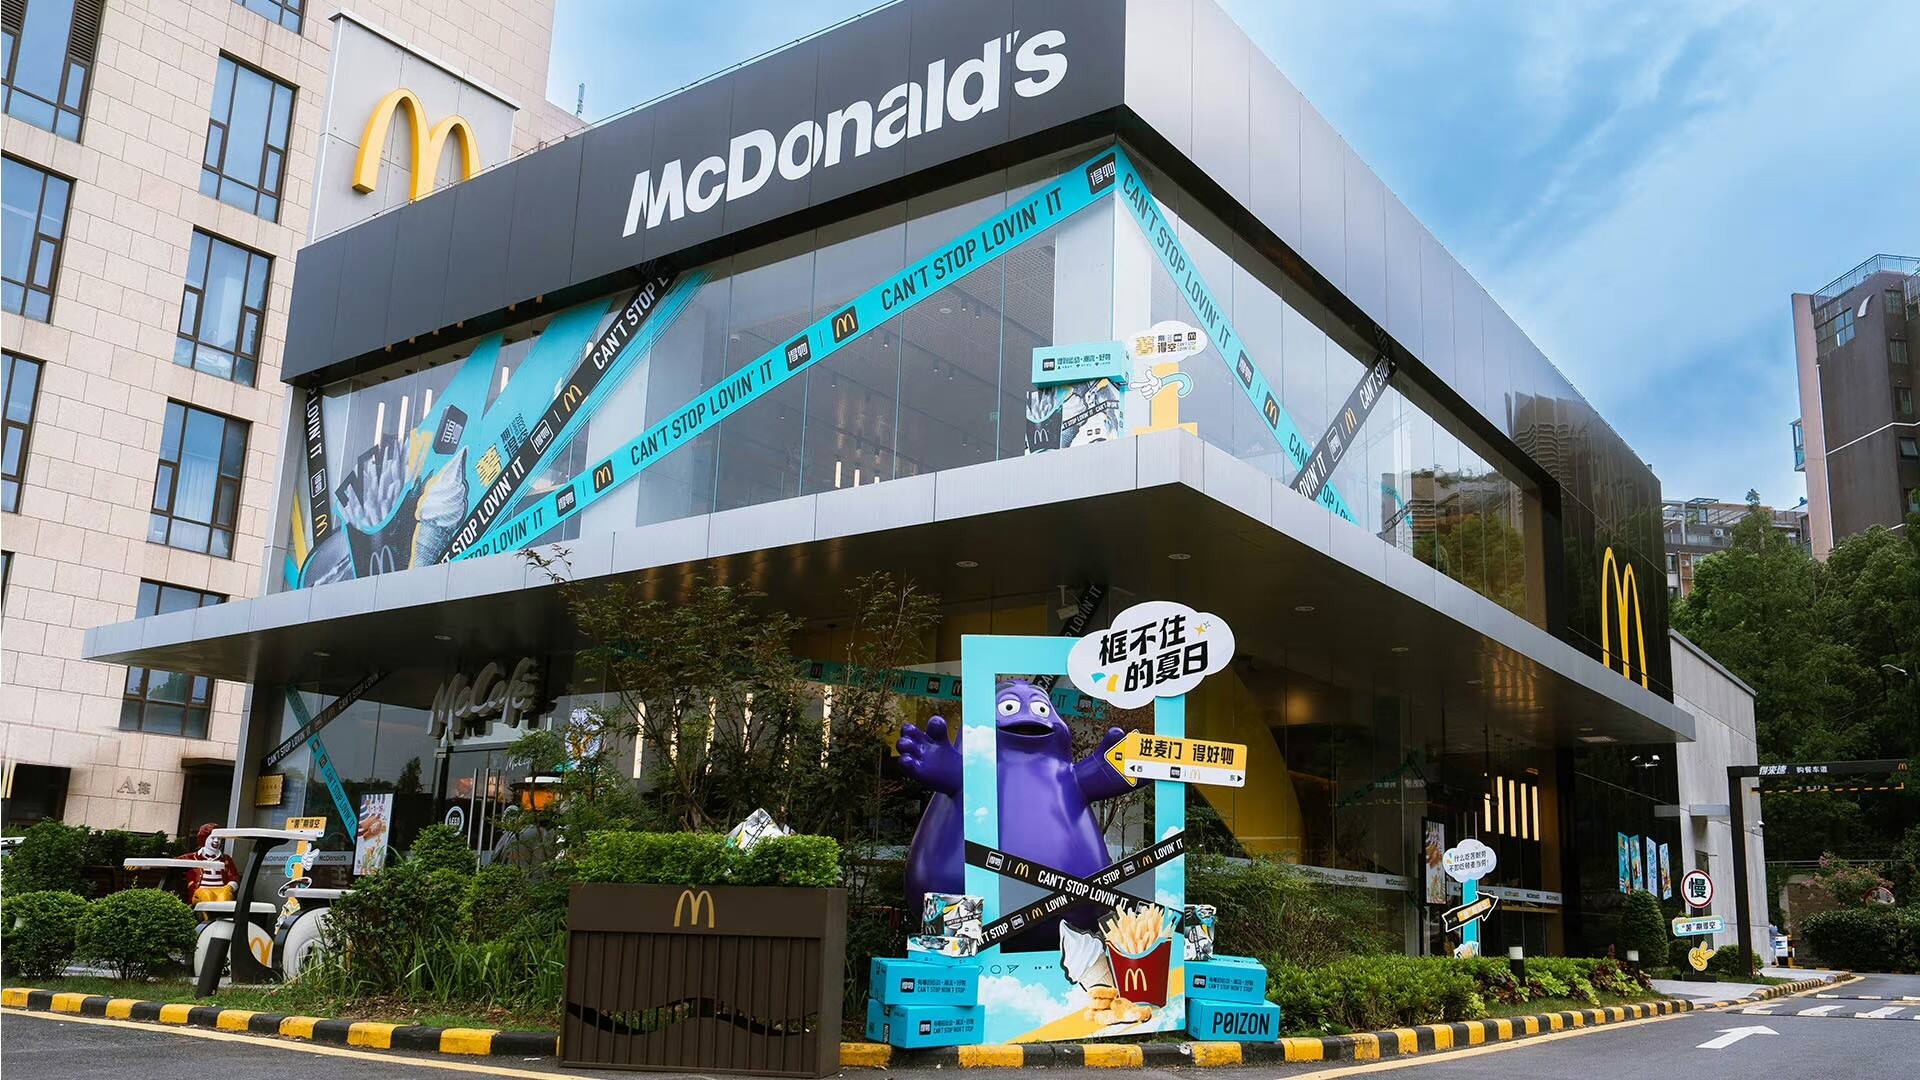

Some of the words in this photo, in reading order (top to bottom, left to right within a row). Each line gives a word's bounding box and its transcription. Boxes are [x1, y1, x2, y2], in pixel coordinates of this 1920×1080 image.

[622, 29, 1068, 238] McDonald's
[881, 265, 928, 311] CAN'T
[934, 241, 975, 280] STOP
[983, 201, 1041, 253] LOVIN'
[1047, 187, 1063, 215] IT
[1122, 173, 1158, 231] CAN'T
[1157, 229, 1186, 273] STOP
[1184, 275, 1220, 328] LOVIN'
[1215, 323, 1231, 350] IT
[593, 320, 628, 370] CAN'T
[626, 282, 656, 327] STOP
[1359, 372, 1378, 410] CAN'T
[306, 399, 321, 442] LOVIN'
[631, 426, 669, 466] CAN'T
[673, 404, 706, 440] STOP
[710, 371, 756, 414] LOVIN'
[760, 359, 774, 383] IT
[310, 443, 323, 460] IT
[1317, 451, 1327, 475] IT
[452, 520, 478, 553] STOP
[478, 473, 513, 525] LOVIN'
[512, 456, 526, 480] IT
[493, 517, 530, 555] LOVIN'
[533, 507, 545, 530] IT
[1099, 614, 1186, 667] 框不住
[1124, 640, 1208, 692] 的夏日
[1140, 738, 1182, 760] 进麦门
[1193, 743, 1235, 765] 得好物
[1759, 765, 1787, 775] 得来速
[1154, 842, 1175, 860] LOVIN'
[1176, 838, 1184, 849] IT
[1037, 870, 1067, 890] CAN'T
[1065, 879, 1090, 897] STOP
[1089, 887, 1119, 907] LOVIN'
[1119, 897, 1129, 911] IT
[1103, 869, 1120, 885] STOP
[1688, 877, 1707, 899] 慢
[989, 922, 1009, 939] STOP
